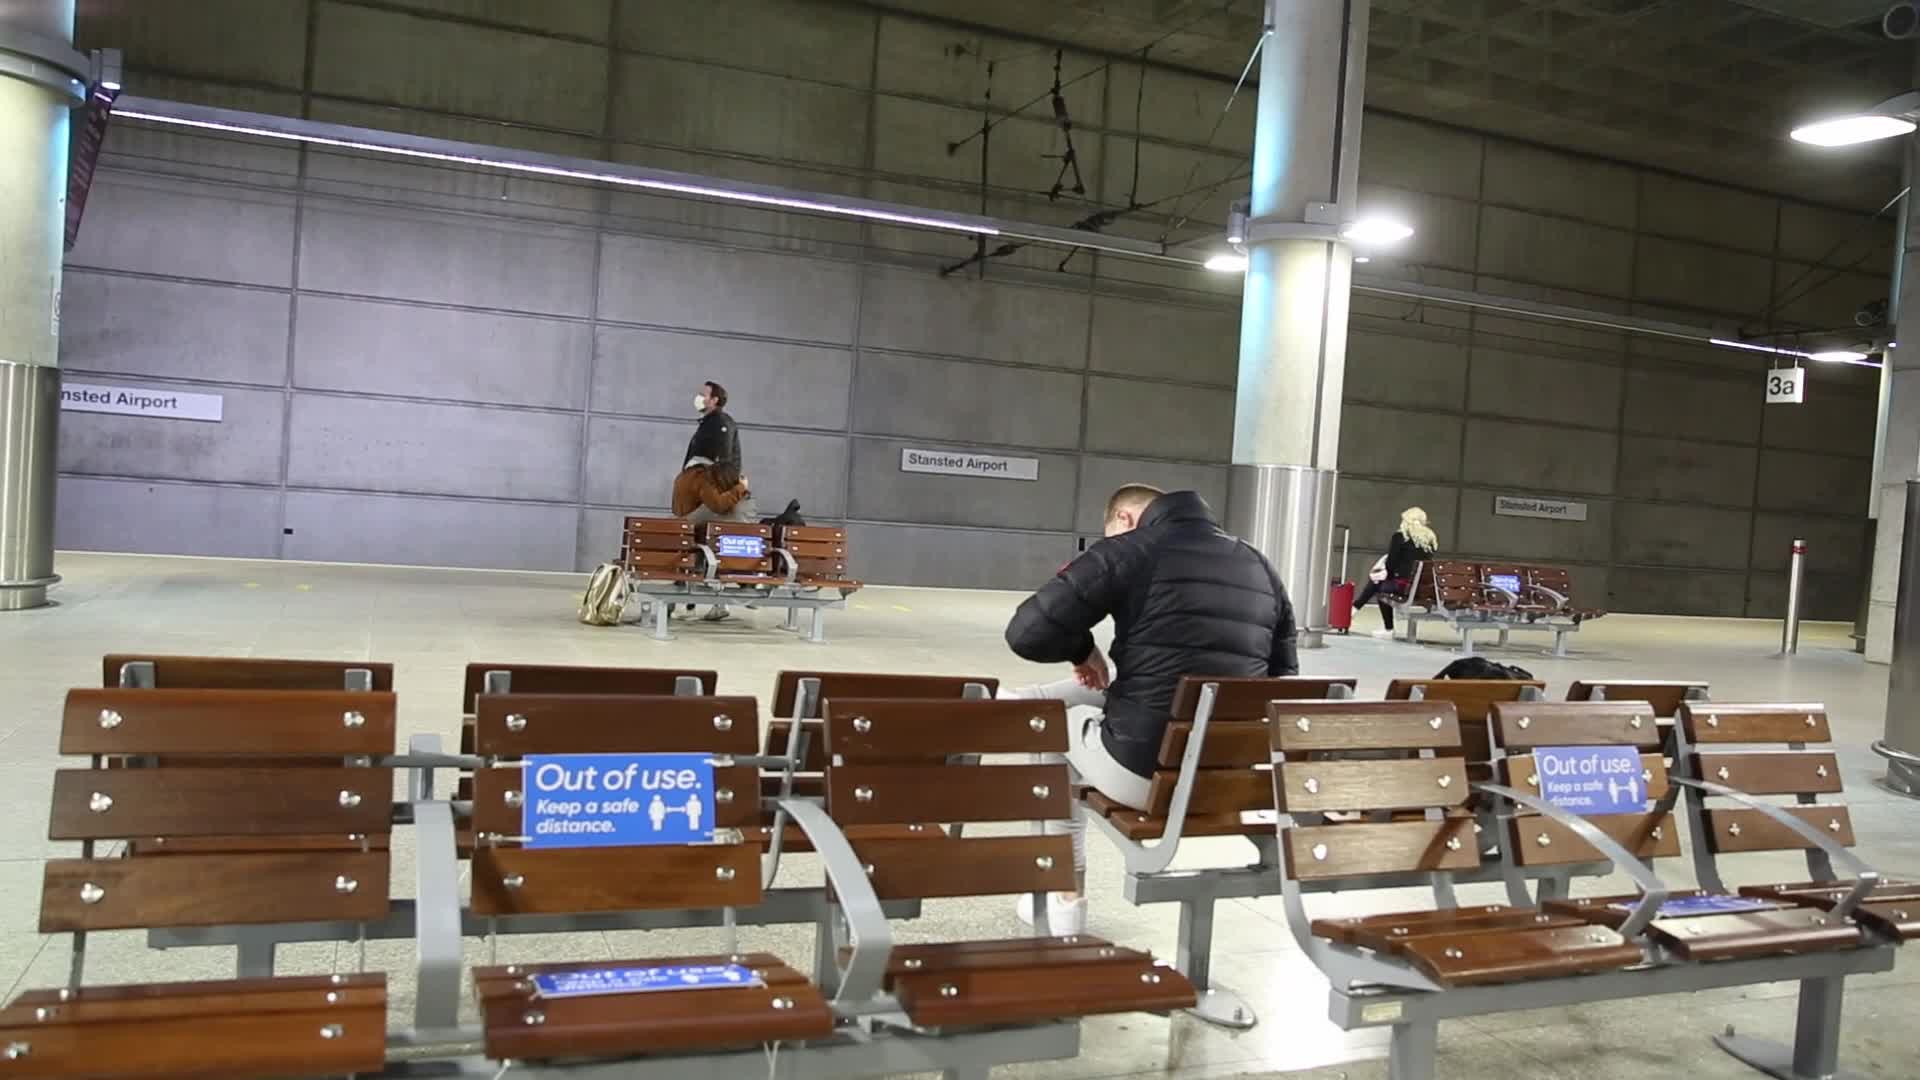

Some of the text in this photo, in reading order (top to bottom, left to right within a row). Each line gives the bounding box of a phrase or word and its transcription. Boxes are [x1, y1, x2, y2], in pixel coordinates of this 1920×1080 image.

[1769, 376, 1794, 395] 3a
[116, 392, 178, 410] Airport
[908, 453, 1008, 472] Stansted Airport
[1543, 753, 1637, 776] Out of use.
[535, 762, 702, 792] Out of use.
[1547, 781, 1573, 794] Keep
[1574, 783, 1582, 793] a
[535, 797, 640, 817] Keep a safe
[535, 818, 616, 835] distance.
